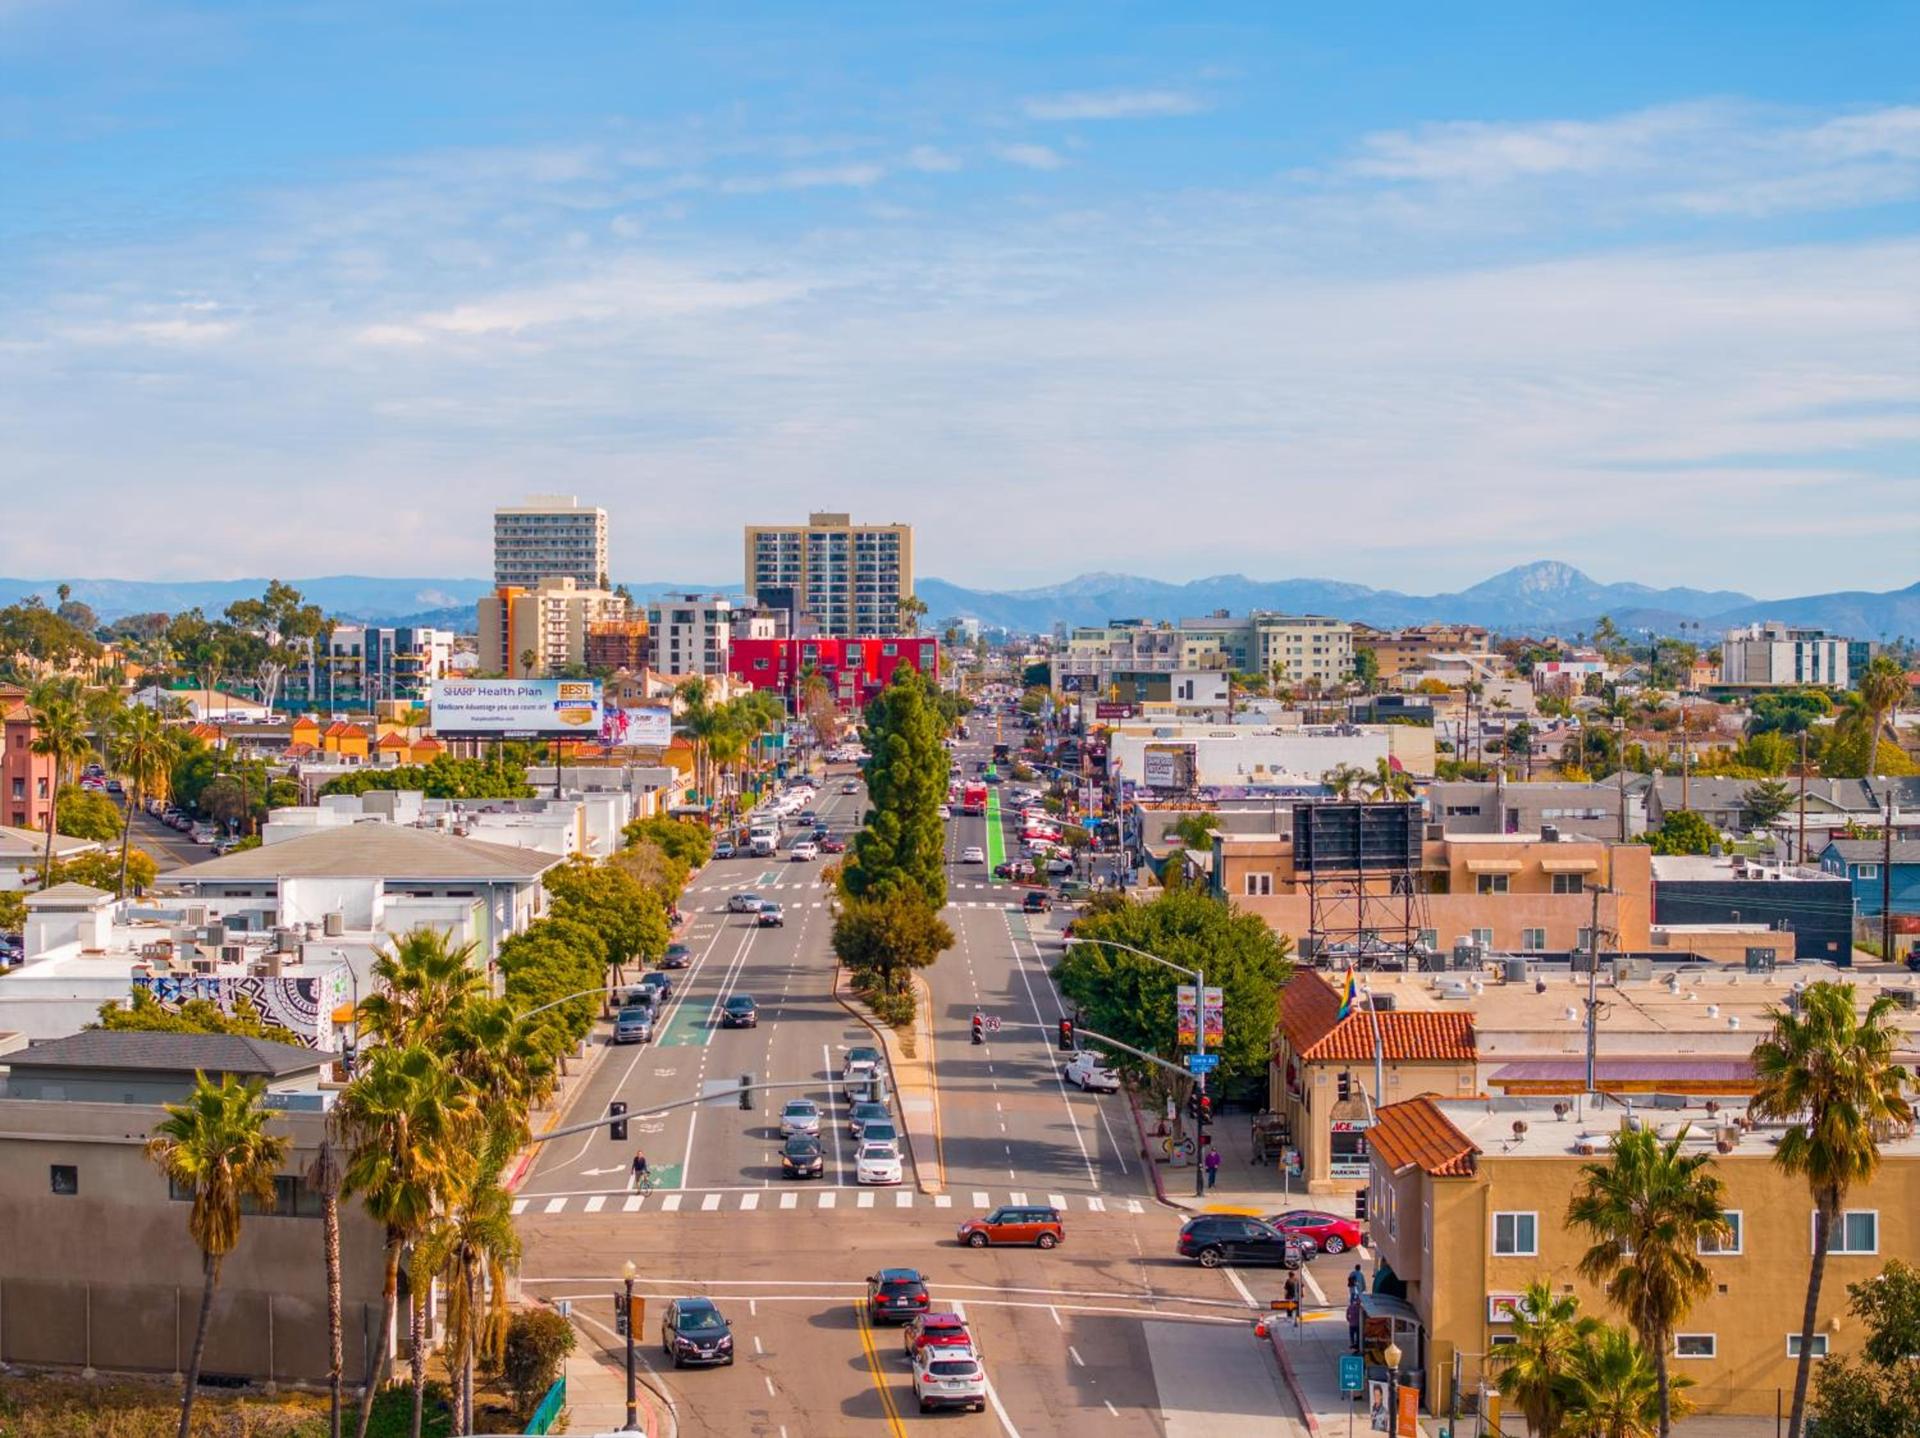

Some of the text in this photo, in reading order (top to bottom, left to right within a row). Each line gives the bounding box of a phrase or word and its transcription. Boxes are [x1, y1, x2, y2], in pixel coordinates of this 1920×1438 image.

[443, 686, 543, 696] SHARP Health Plan
[560, 683, 591, 694] BEST
[1332, 1122, 1353, 1131] ACE
